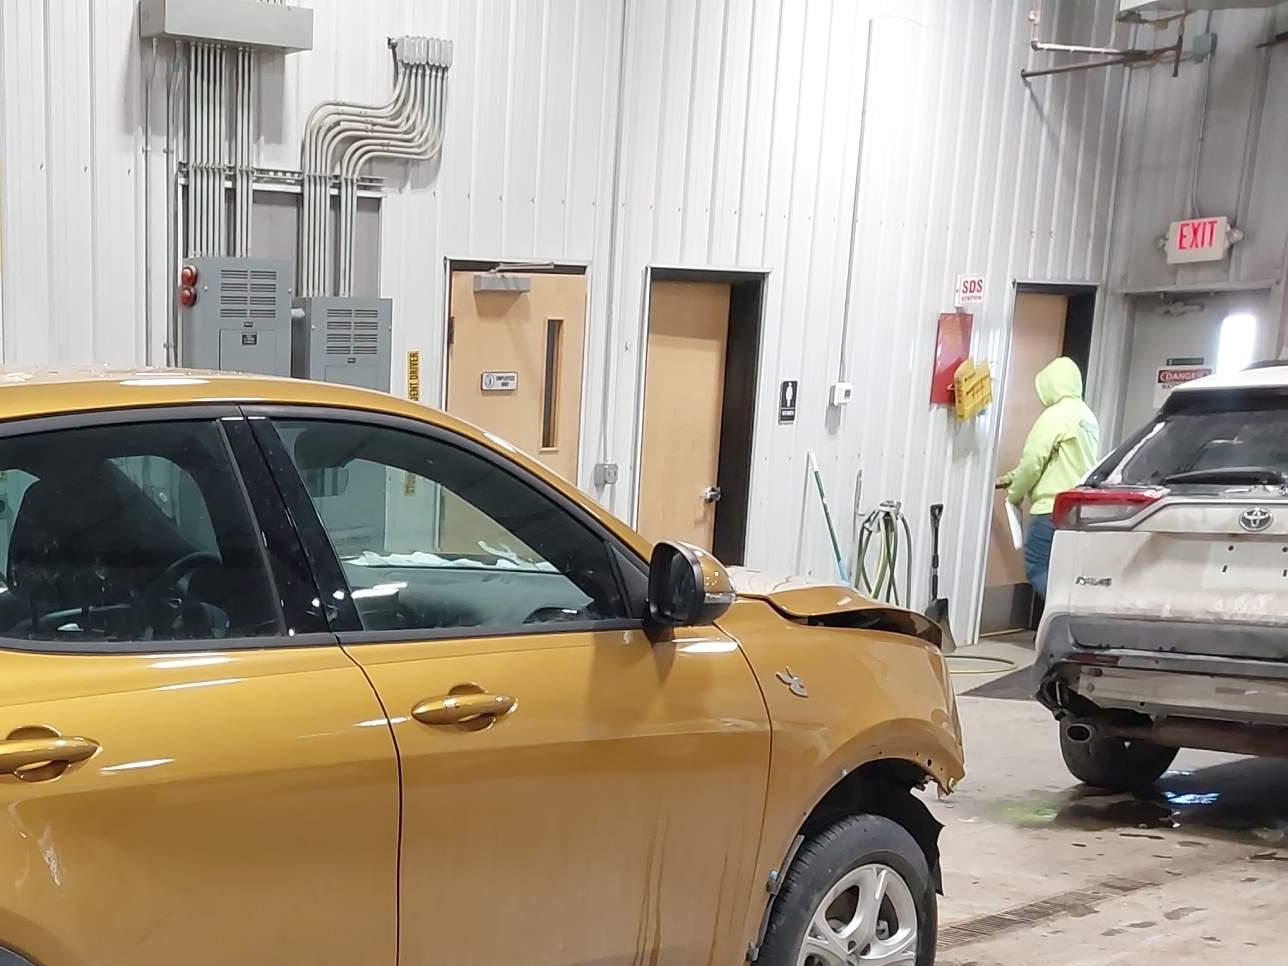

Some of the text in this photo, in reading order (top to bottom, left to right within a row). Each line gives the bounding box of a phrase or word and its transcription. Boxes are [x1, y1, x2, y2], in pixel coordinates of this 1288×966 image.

[1178, 220, 1218, 250] EXIT
[962, 279, 983, 294] SDS
[409, 352, 419, 380] DRIVER
